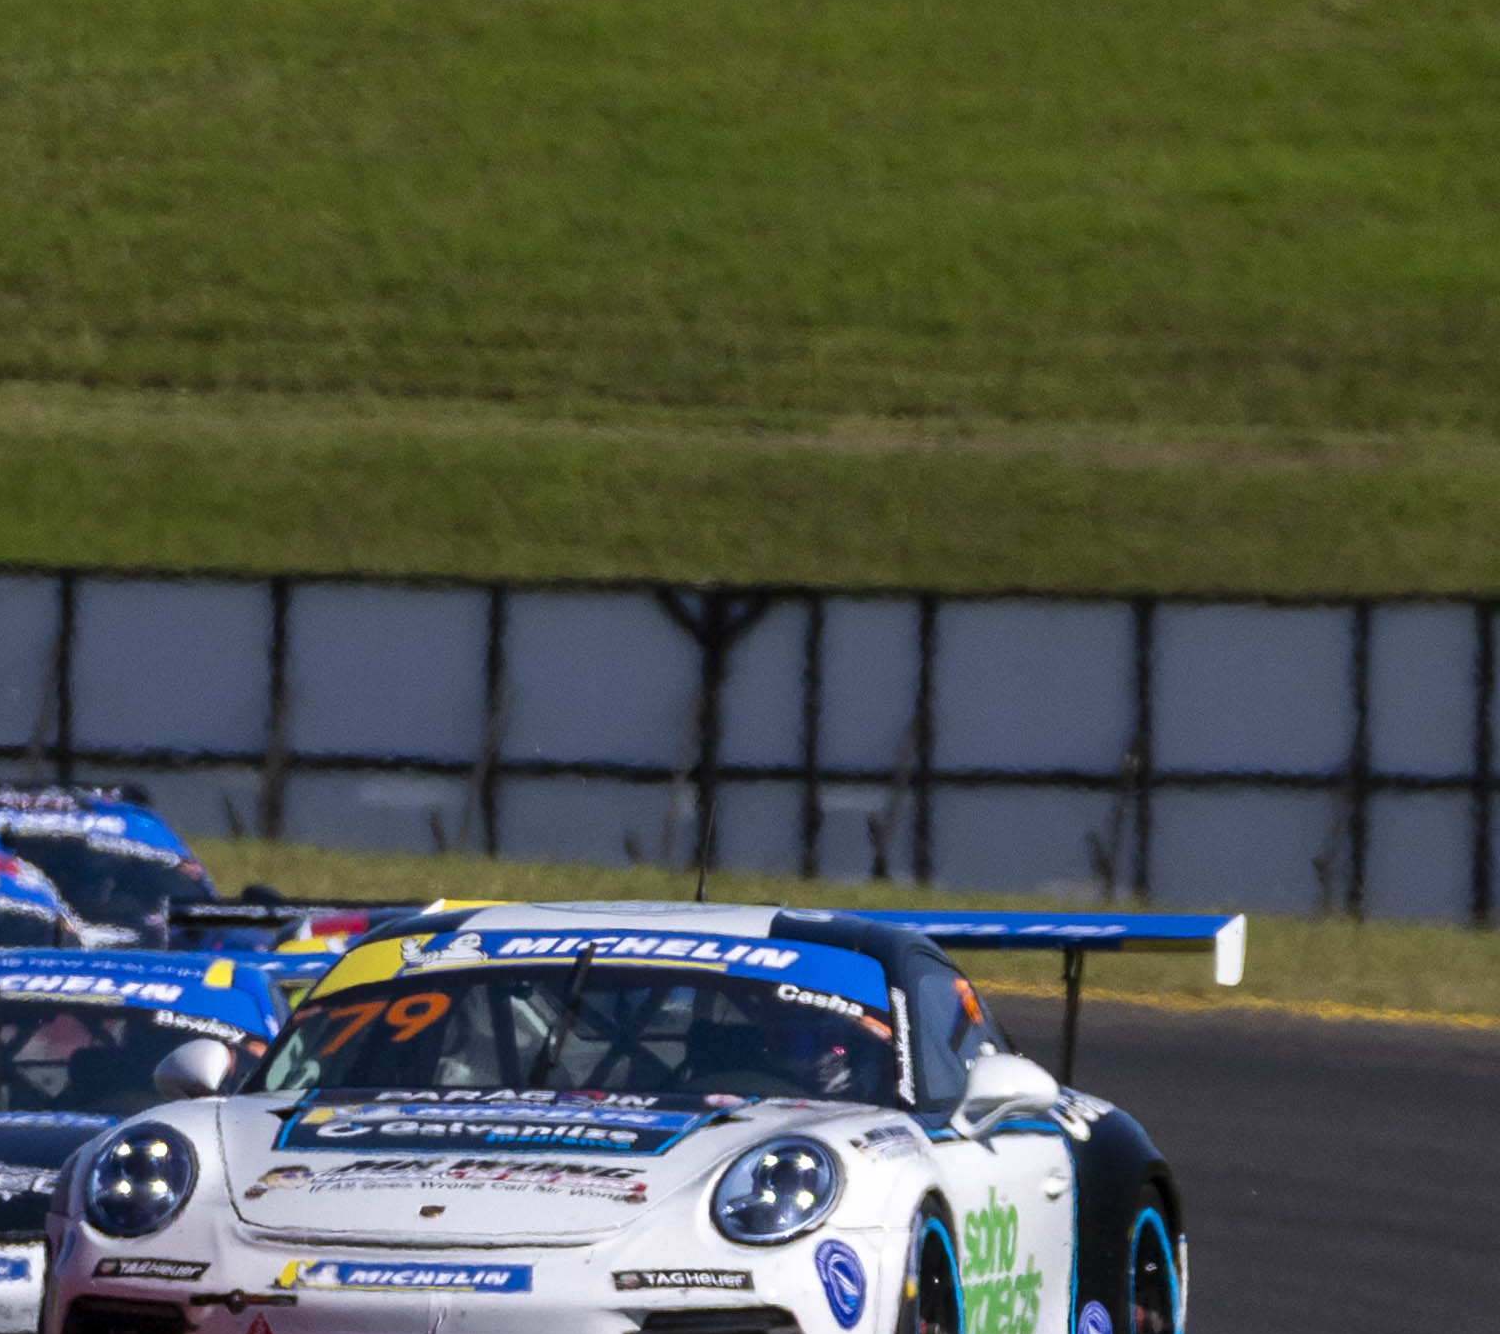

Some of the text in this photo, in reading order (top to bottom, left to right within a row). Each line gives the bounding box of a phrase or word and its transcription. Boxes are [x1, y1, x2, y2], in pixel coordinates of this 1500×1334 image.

[500, 936, 801, 969] MICHELIN
[776, 983, 864, 1018] Casha
[318, 992, 452, 1057] 79
[346, 1268, 512, 1285] MICHELIN
